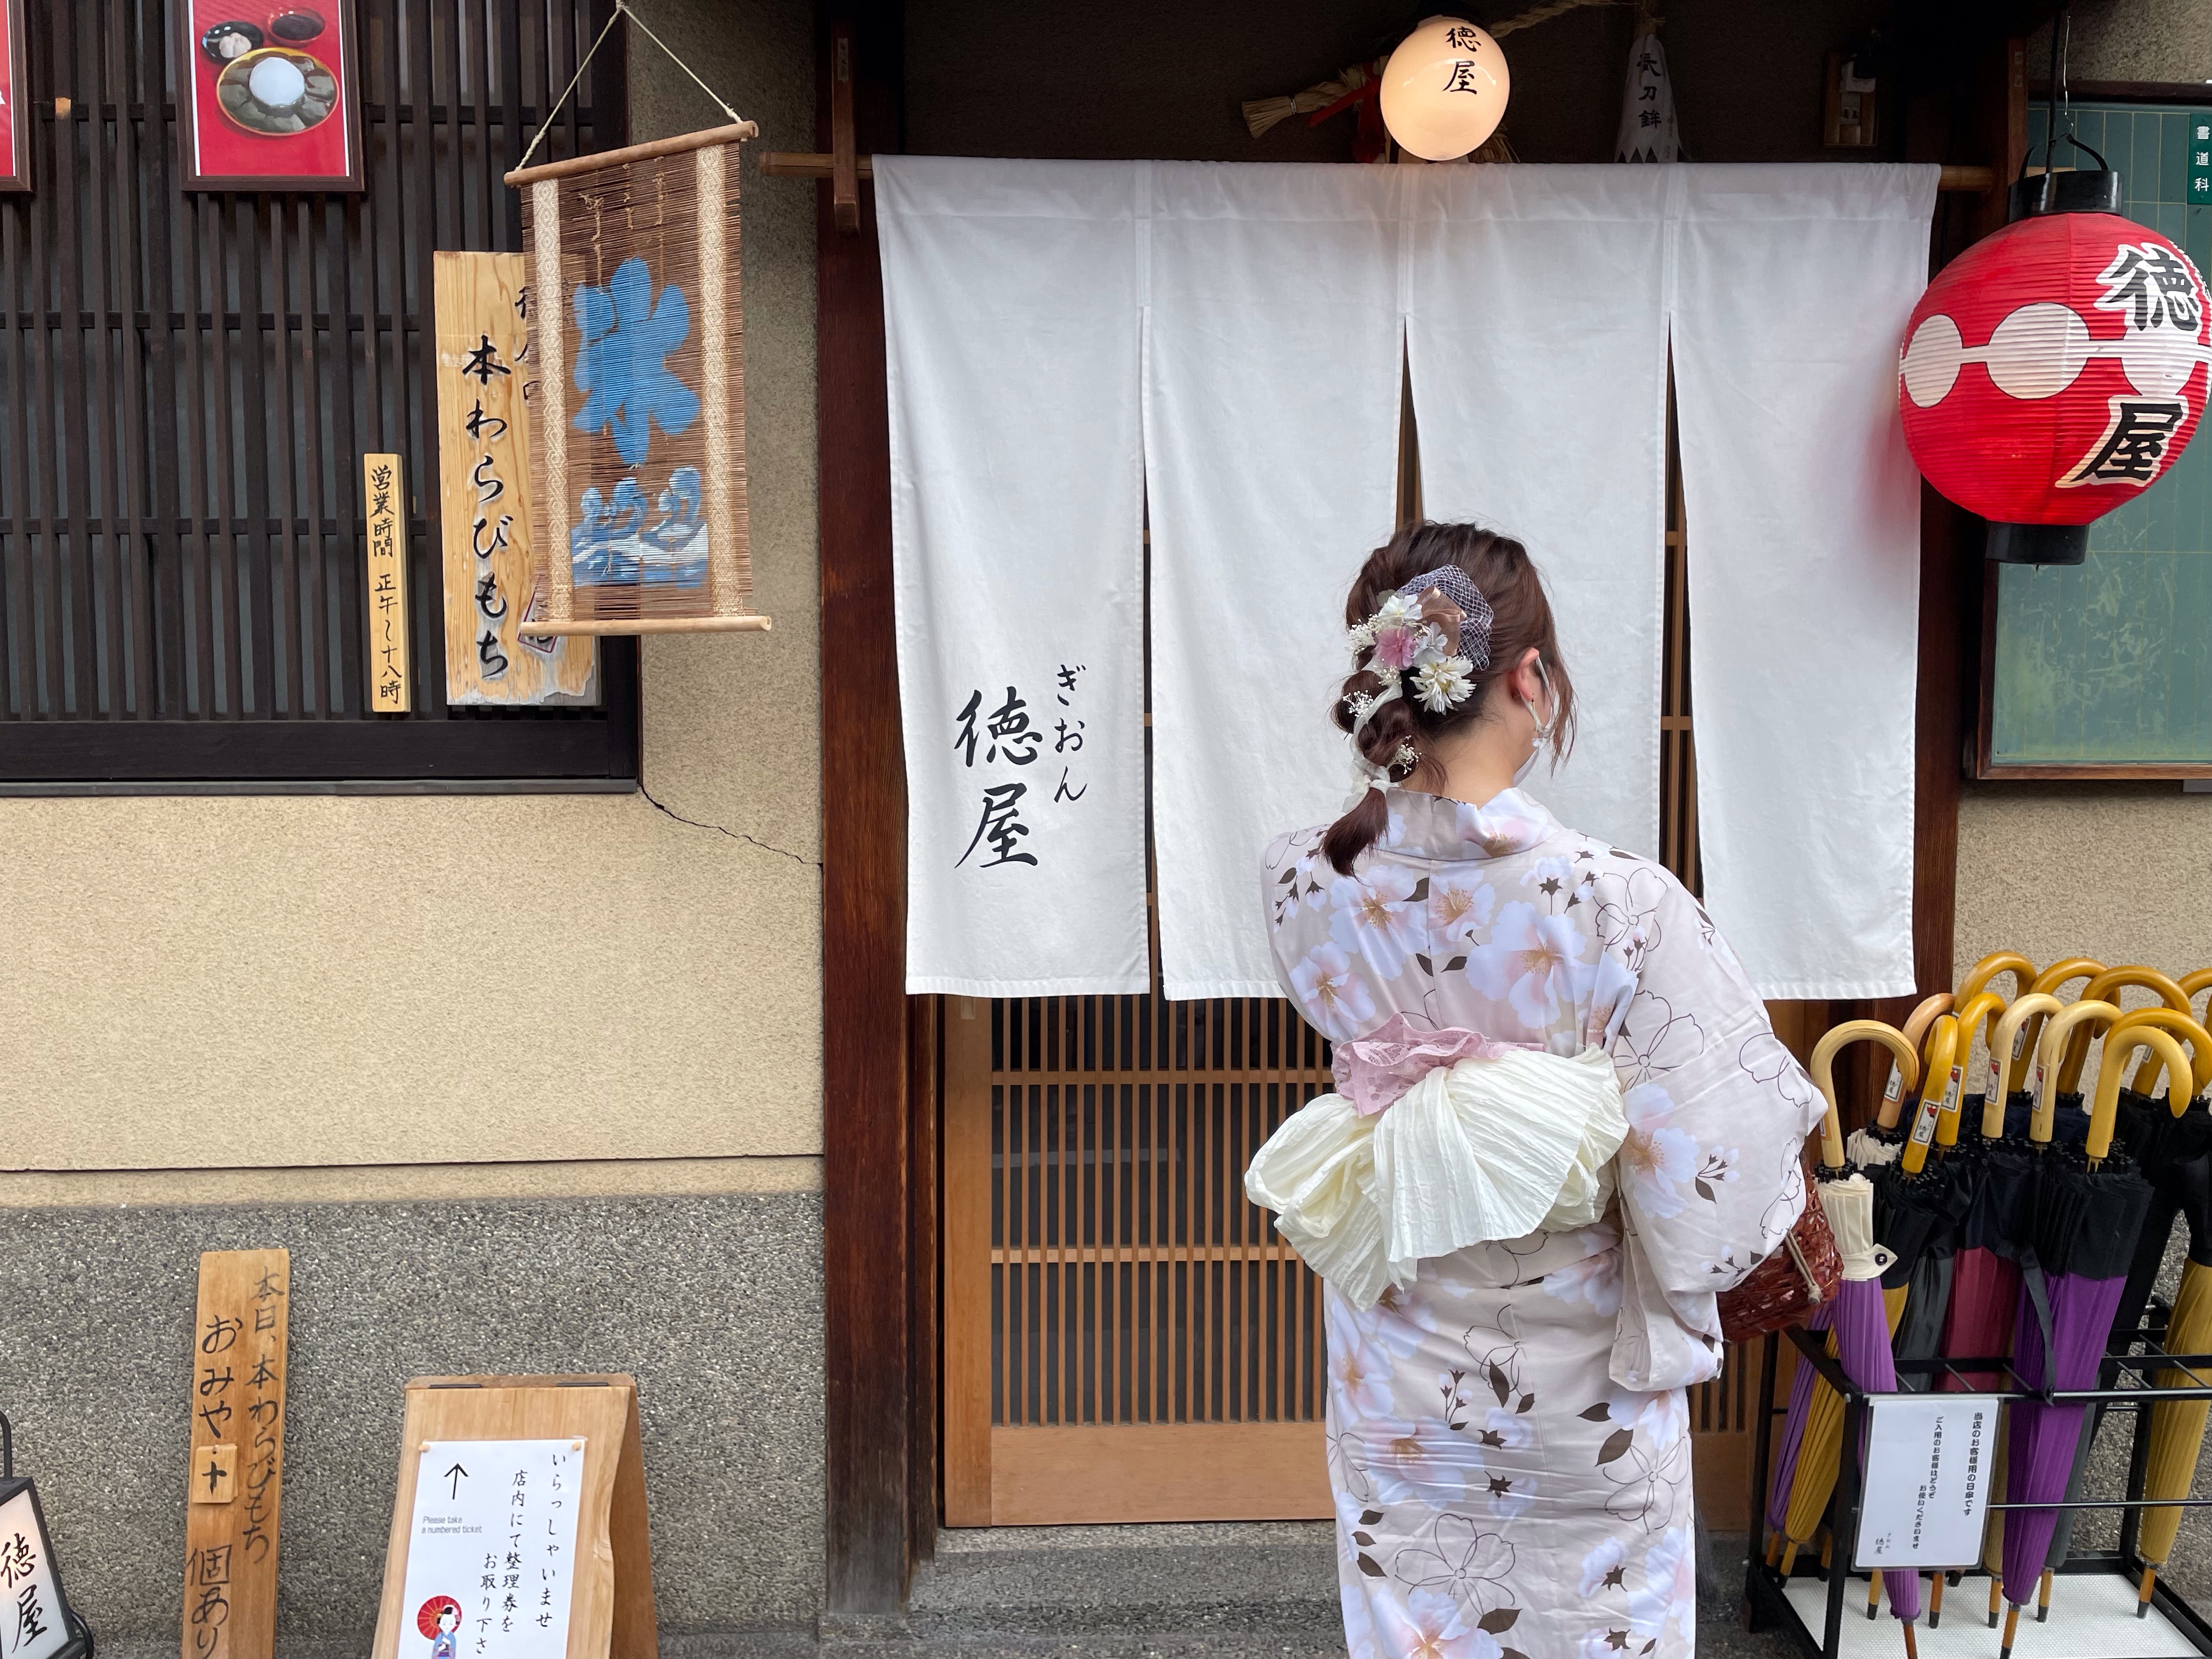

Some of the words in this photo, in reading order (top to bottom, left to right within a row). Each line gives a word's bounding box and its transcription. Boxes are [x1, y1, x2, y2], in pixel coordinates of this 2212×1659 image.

[1442, 26, 1481, 95] 徳屋
[1637, 53, 1662, 129] 長刀鉾
[2194, 125, 2210, 192] 書道科
[2068, 246, 2200, 482] 徳屋
[369, 464, 394, 558] 営業時間
[462, 335, 511, 679] 本わらびもち
[953, 686, 1043, 869] 徳屋
[1054, 664, 1087, 803] ぎおん
[1963, 1412, 1983, 1516] 当店のお客様用の日傘です
[462, 1525, 482, 1533] ticket
[501, 1469, 529, 1633] 店内にて整理券を
[535, 1453, 566, 1628] いらっしゃいませ
[1, 1532, 48, 1654] 徳屋
